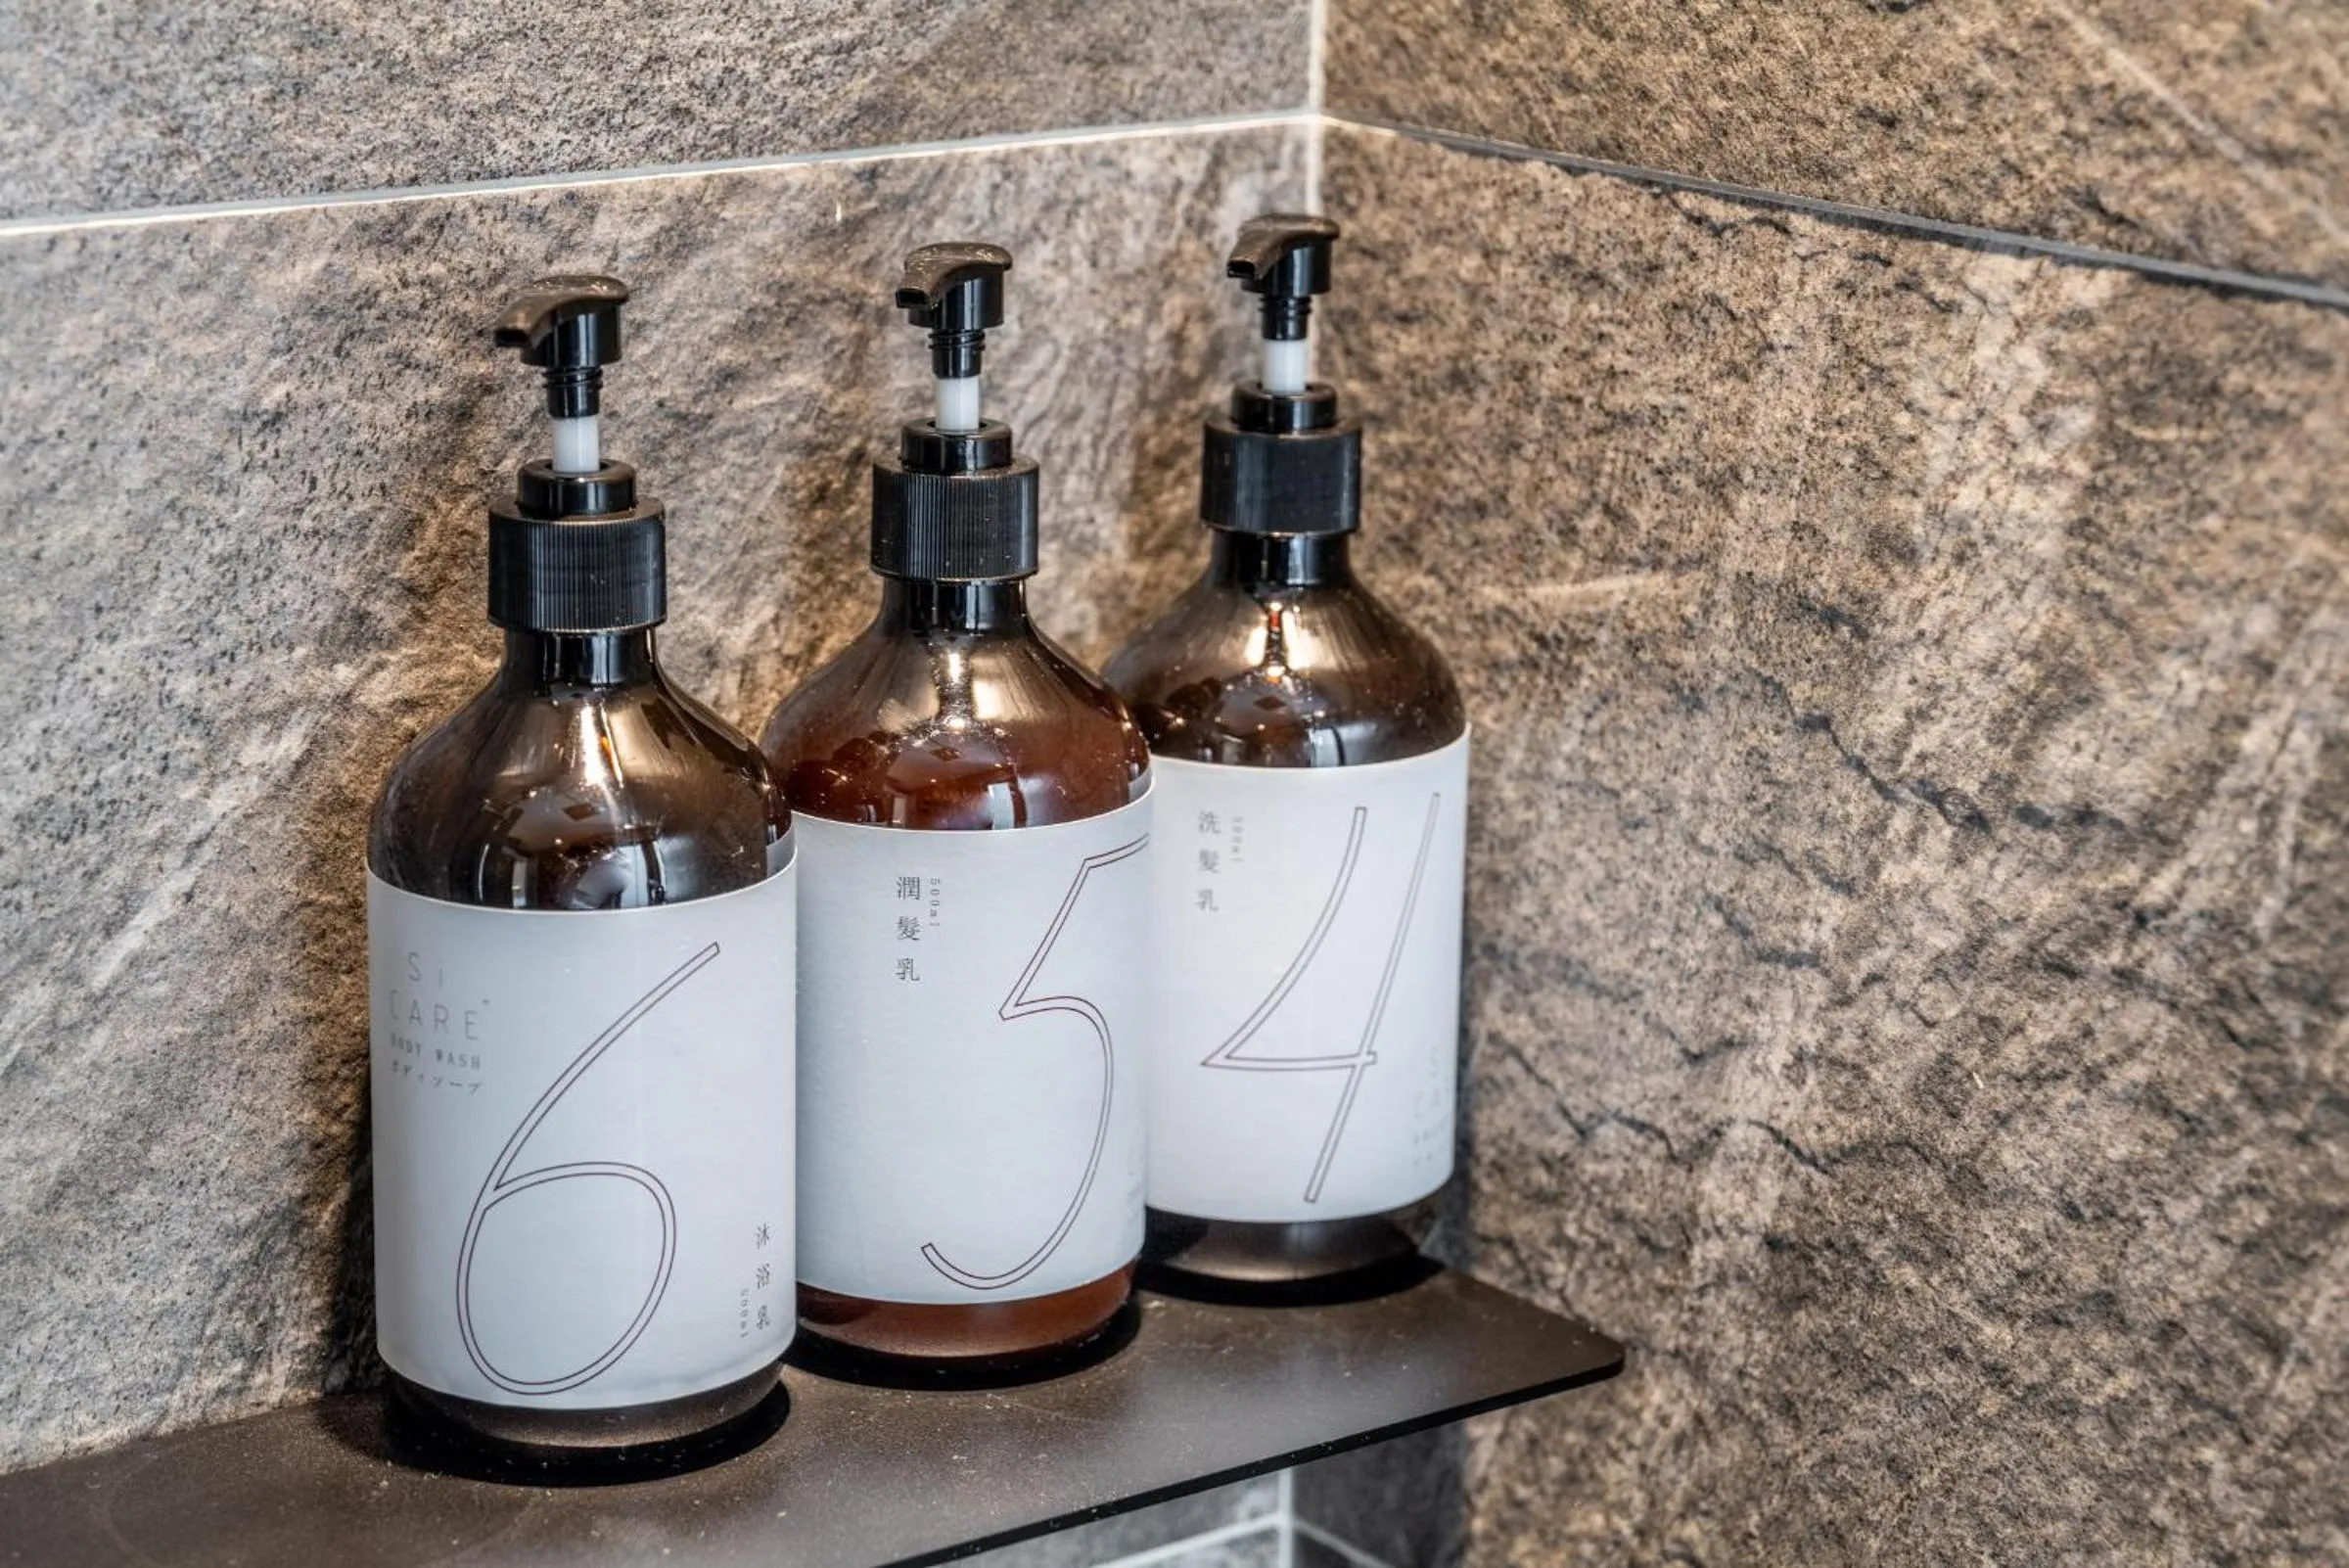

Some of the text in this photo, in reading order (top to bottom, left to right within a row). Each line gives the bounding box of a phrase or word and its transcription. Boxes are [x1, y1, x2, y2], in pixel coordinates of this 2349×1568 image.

[895, 876, 921, 982] 潤髮乳
[918, 833, 1150, 1289] 5
[1200, 793, 1441, 1203] 4
[457, 942, 720, 1395] 6
